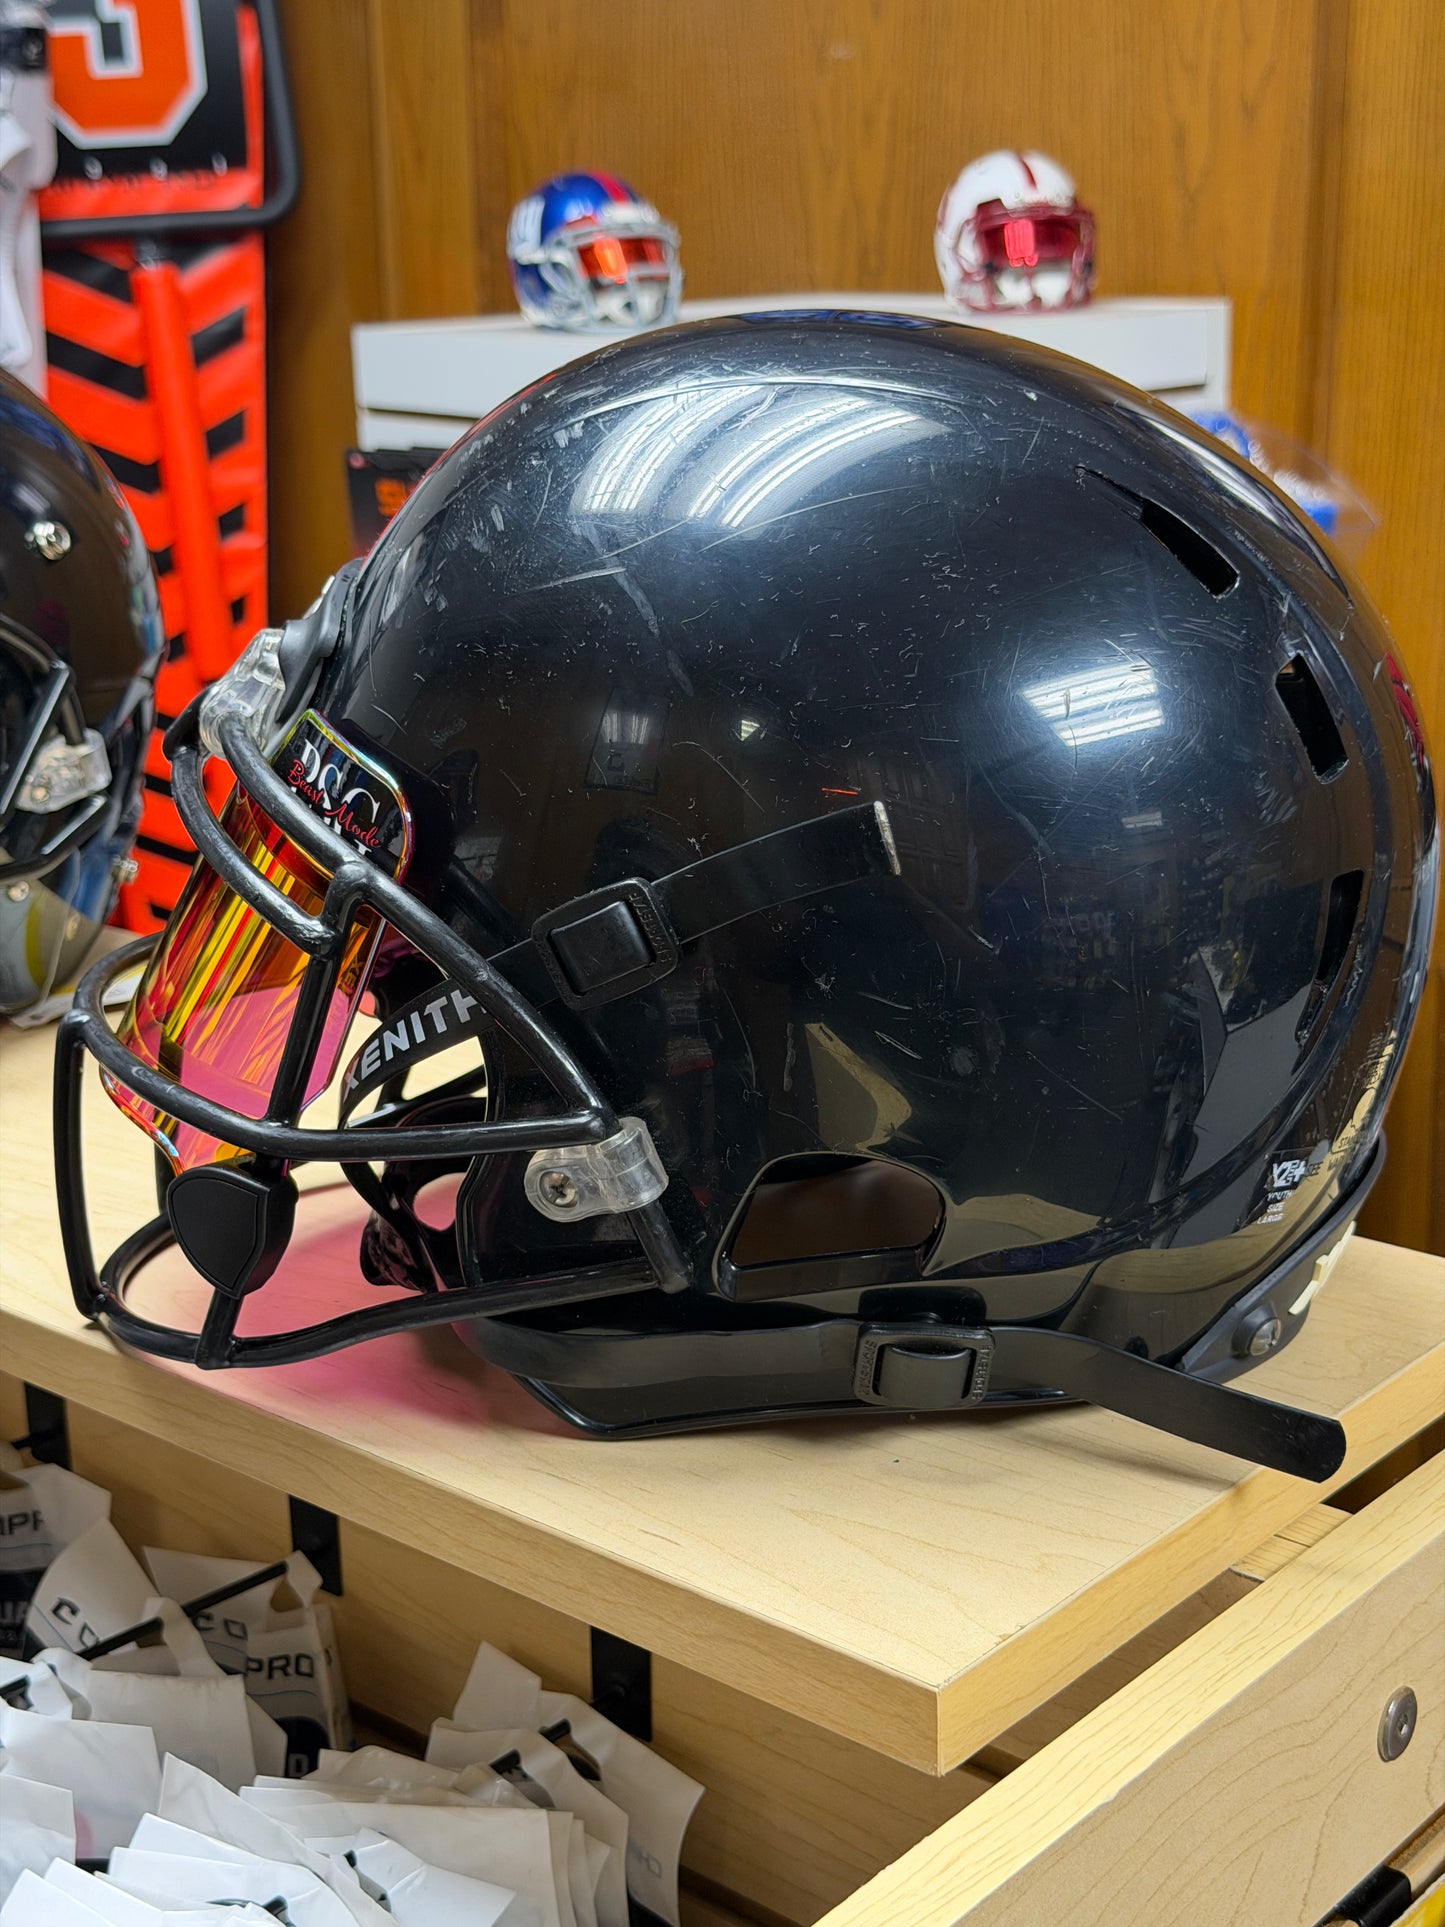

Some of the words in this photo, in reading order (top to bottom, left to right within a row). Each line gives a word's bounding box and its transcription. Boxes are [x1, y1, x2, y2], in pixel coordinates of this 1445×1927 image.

[287, 759, 325, 804] Beast
[324, 803, 381, 849] Mode
[343, 989, 487, 1103] XENITH
